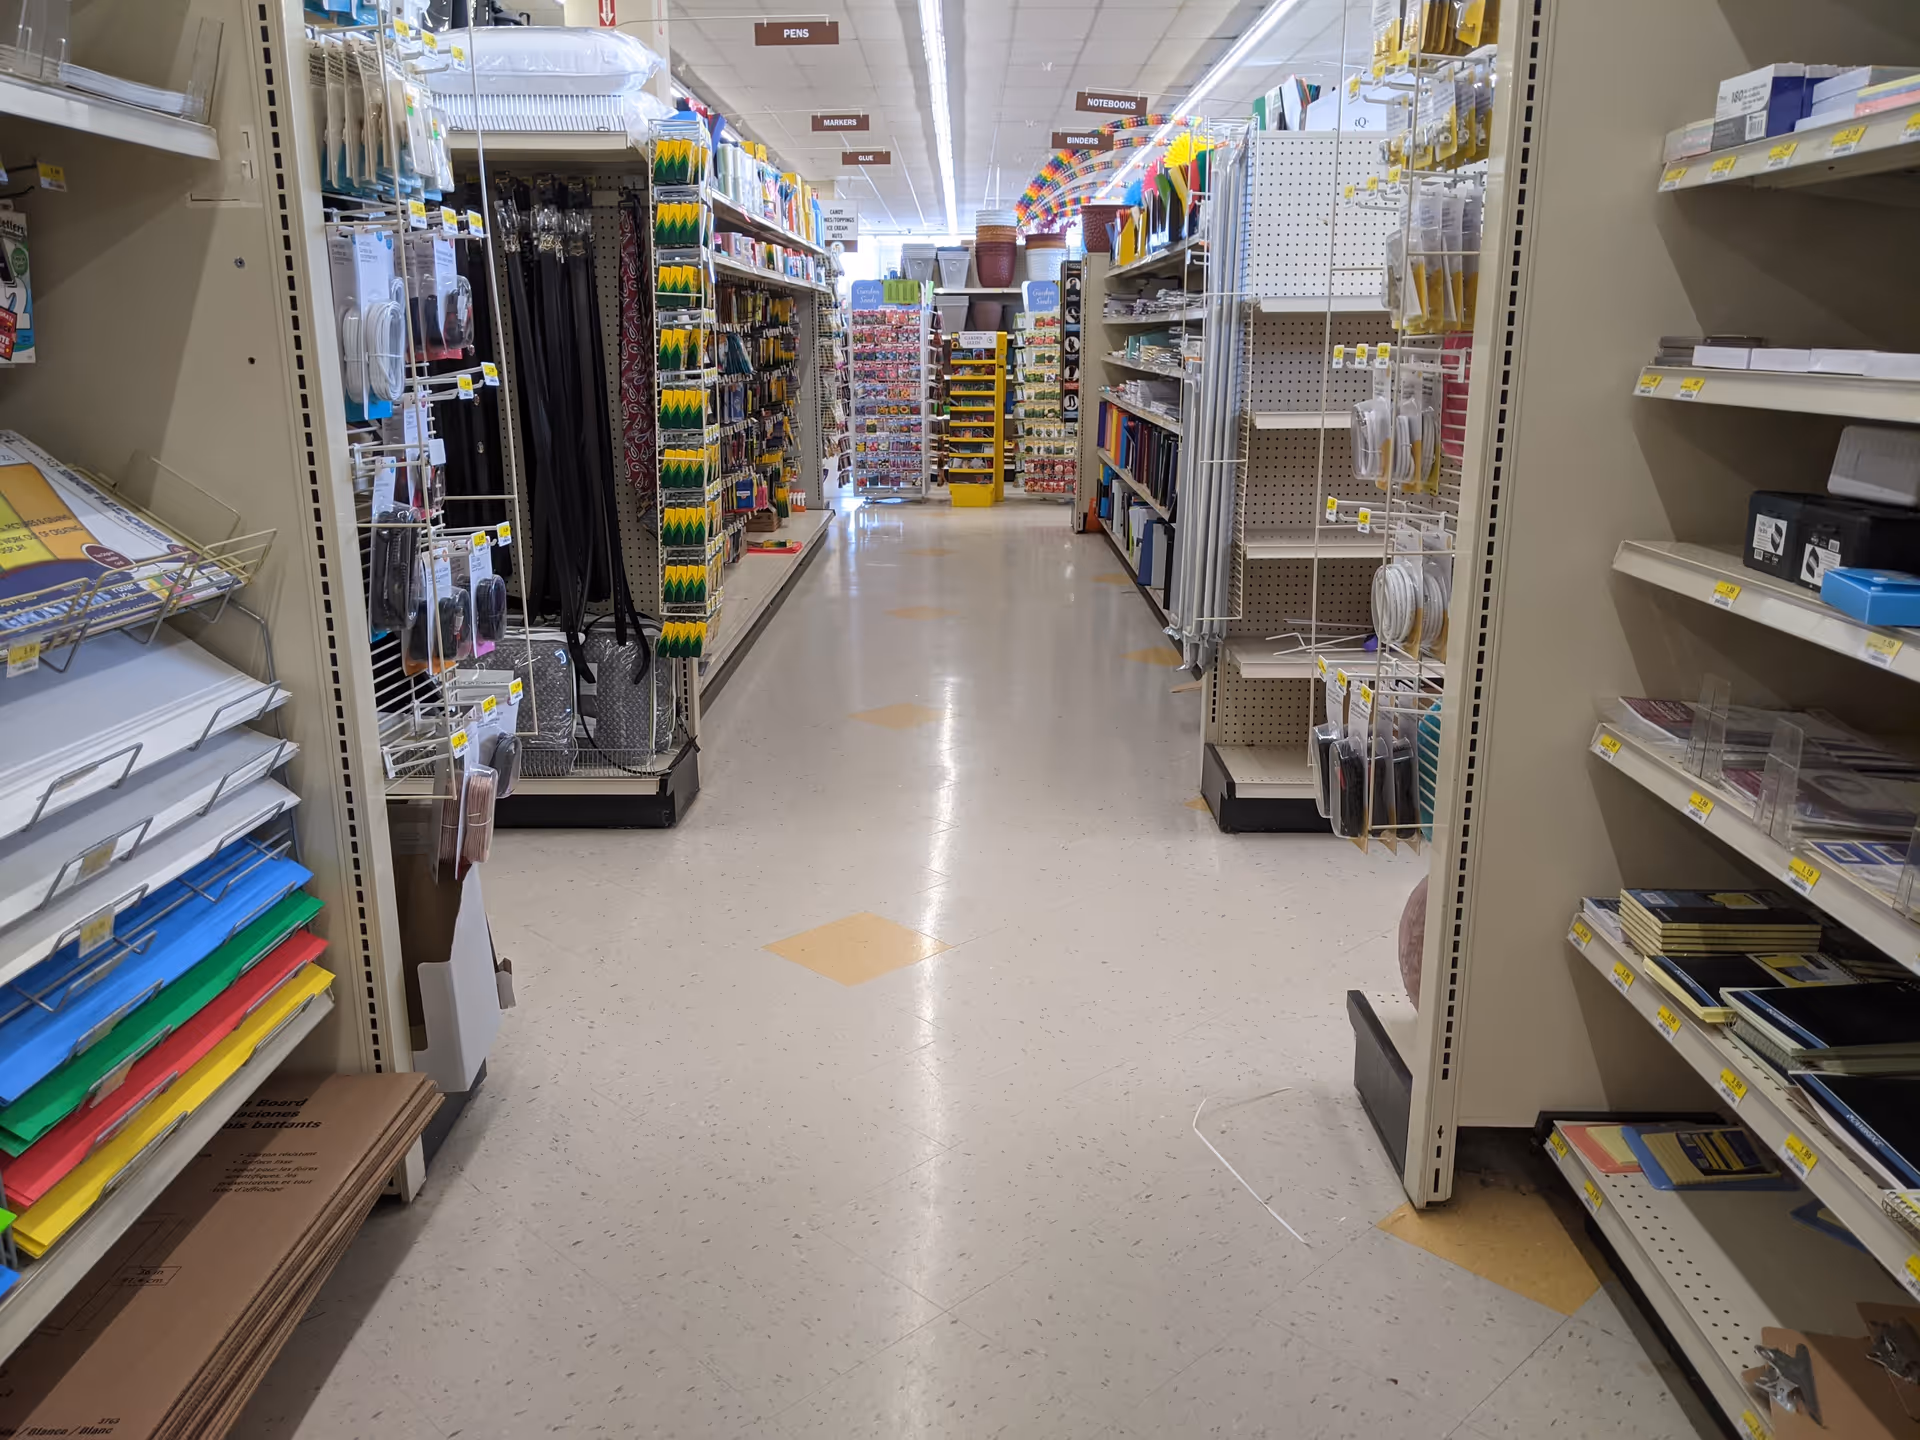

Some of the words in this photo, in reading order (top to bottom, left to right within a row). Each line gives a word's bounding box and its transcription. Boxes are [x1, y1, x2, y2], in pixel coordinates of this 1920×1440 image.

[783, 28, 810, 38] PENS
[1087, 98, 1137, 110] NOTEBOOKS
[823, 118, 857, 126] MARKERS
[1066, 136, 1099, 145] BINDERS
[856, 285, 880, 295] Garden
[1032, 287, 1055, 297] Garden
[859, 295, 877, 304] Seeds
[256, 1098, 309, 1107] Board
[251, 1120, 323, 1129] battants
[98, 1417, 121, 1425] 3763
[27, 1426, 70, 1436] Blanco
[77, 1425, 115, 1435] Blanc
